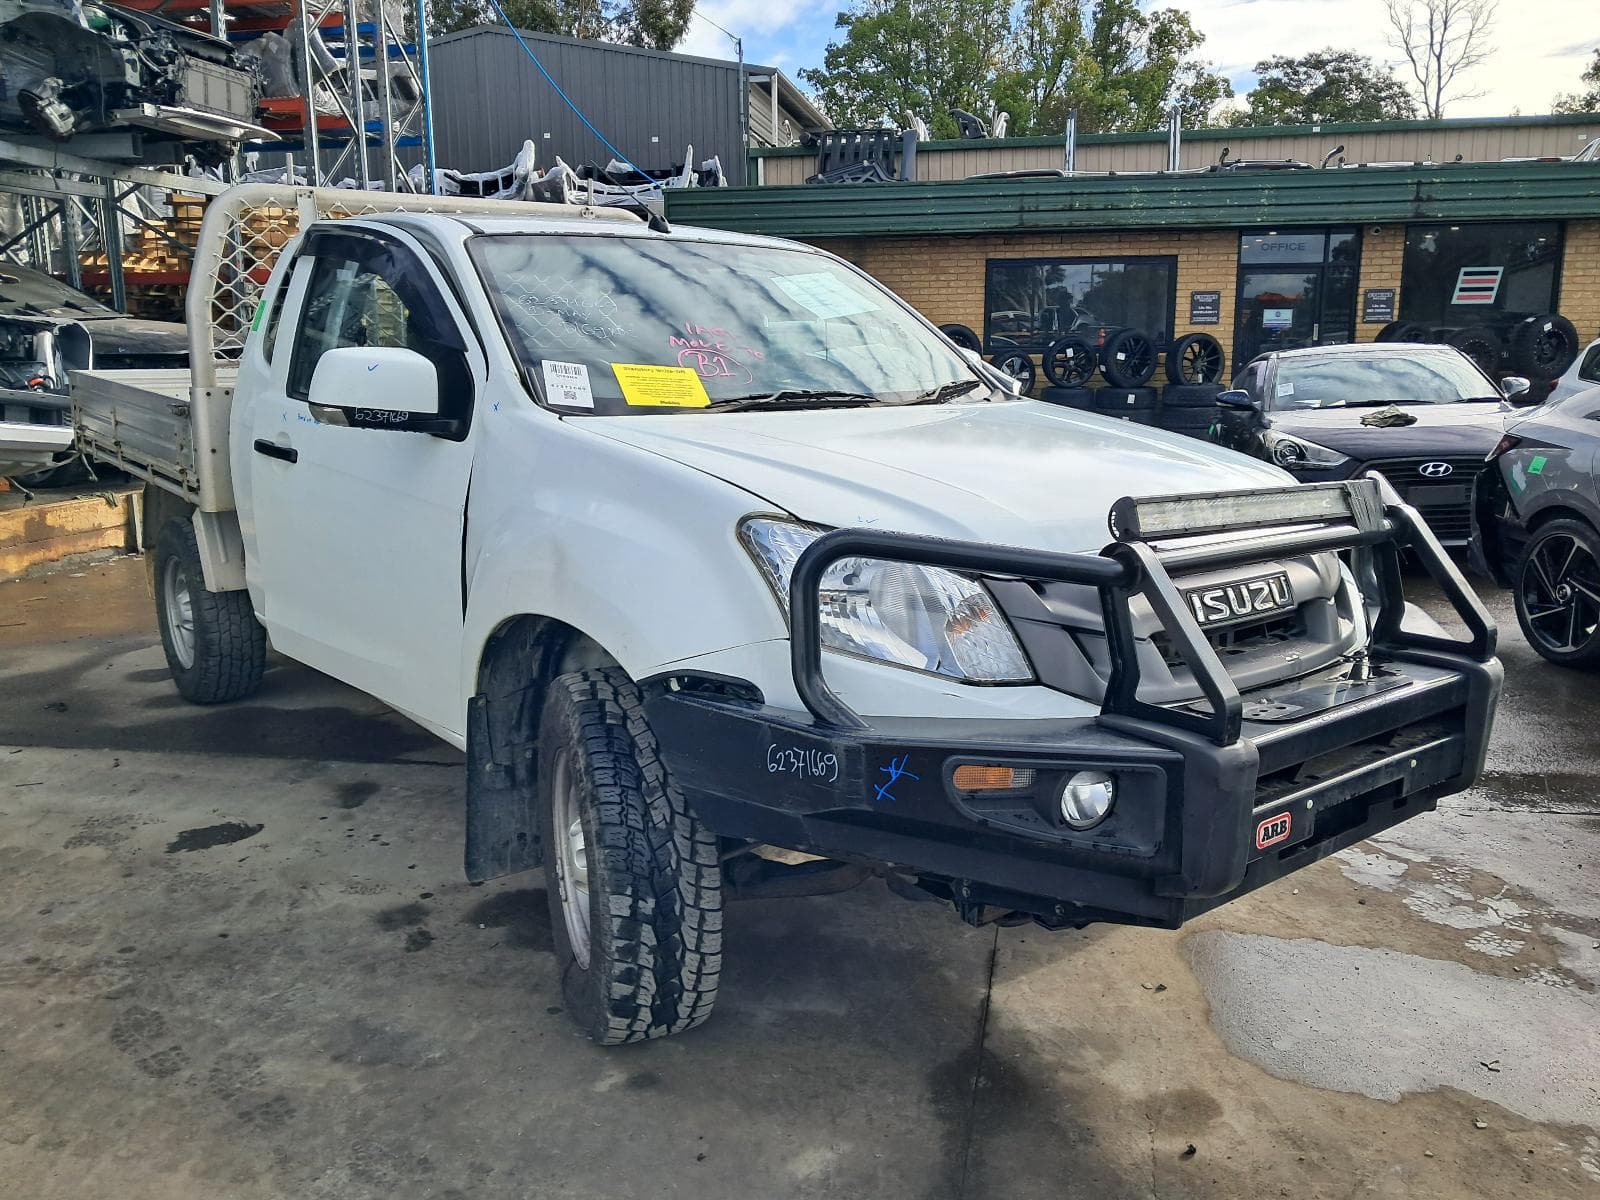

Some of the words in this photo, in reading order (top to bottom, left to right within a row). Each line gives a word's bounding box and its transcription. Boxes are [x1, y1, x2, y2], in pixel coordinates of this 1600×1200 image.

[1261, 242, 1305, 251] OFFICE
[355, 407, 409, 424] 62371669
[1190, 576, 1290, 623] ISUZU
[767, 743, 839, 783] 62371669
[1261, 819, 1288, 843] ARB
